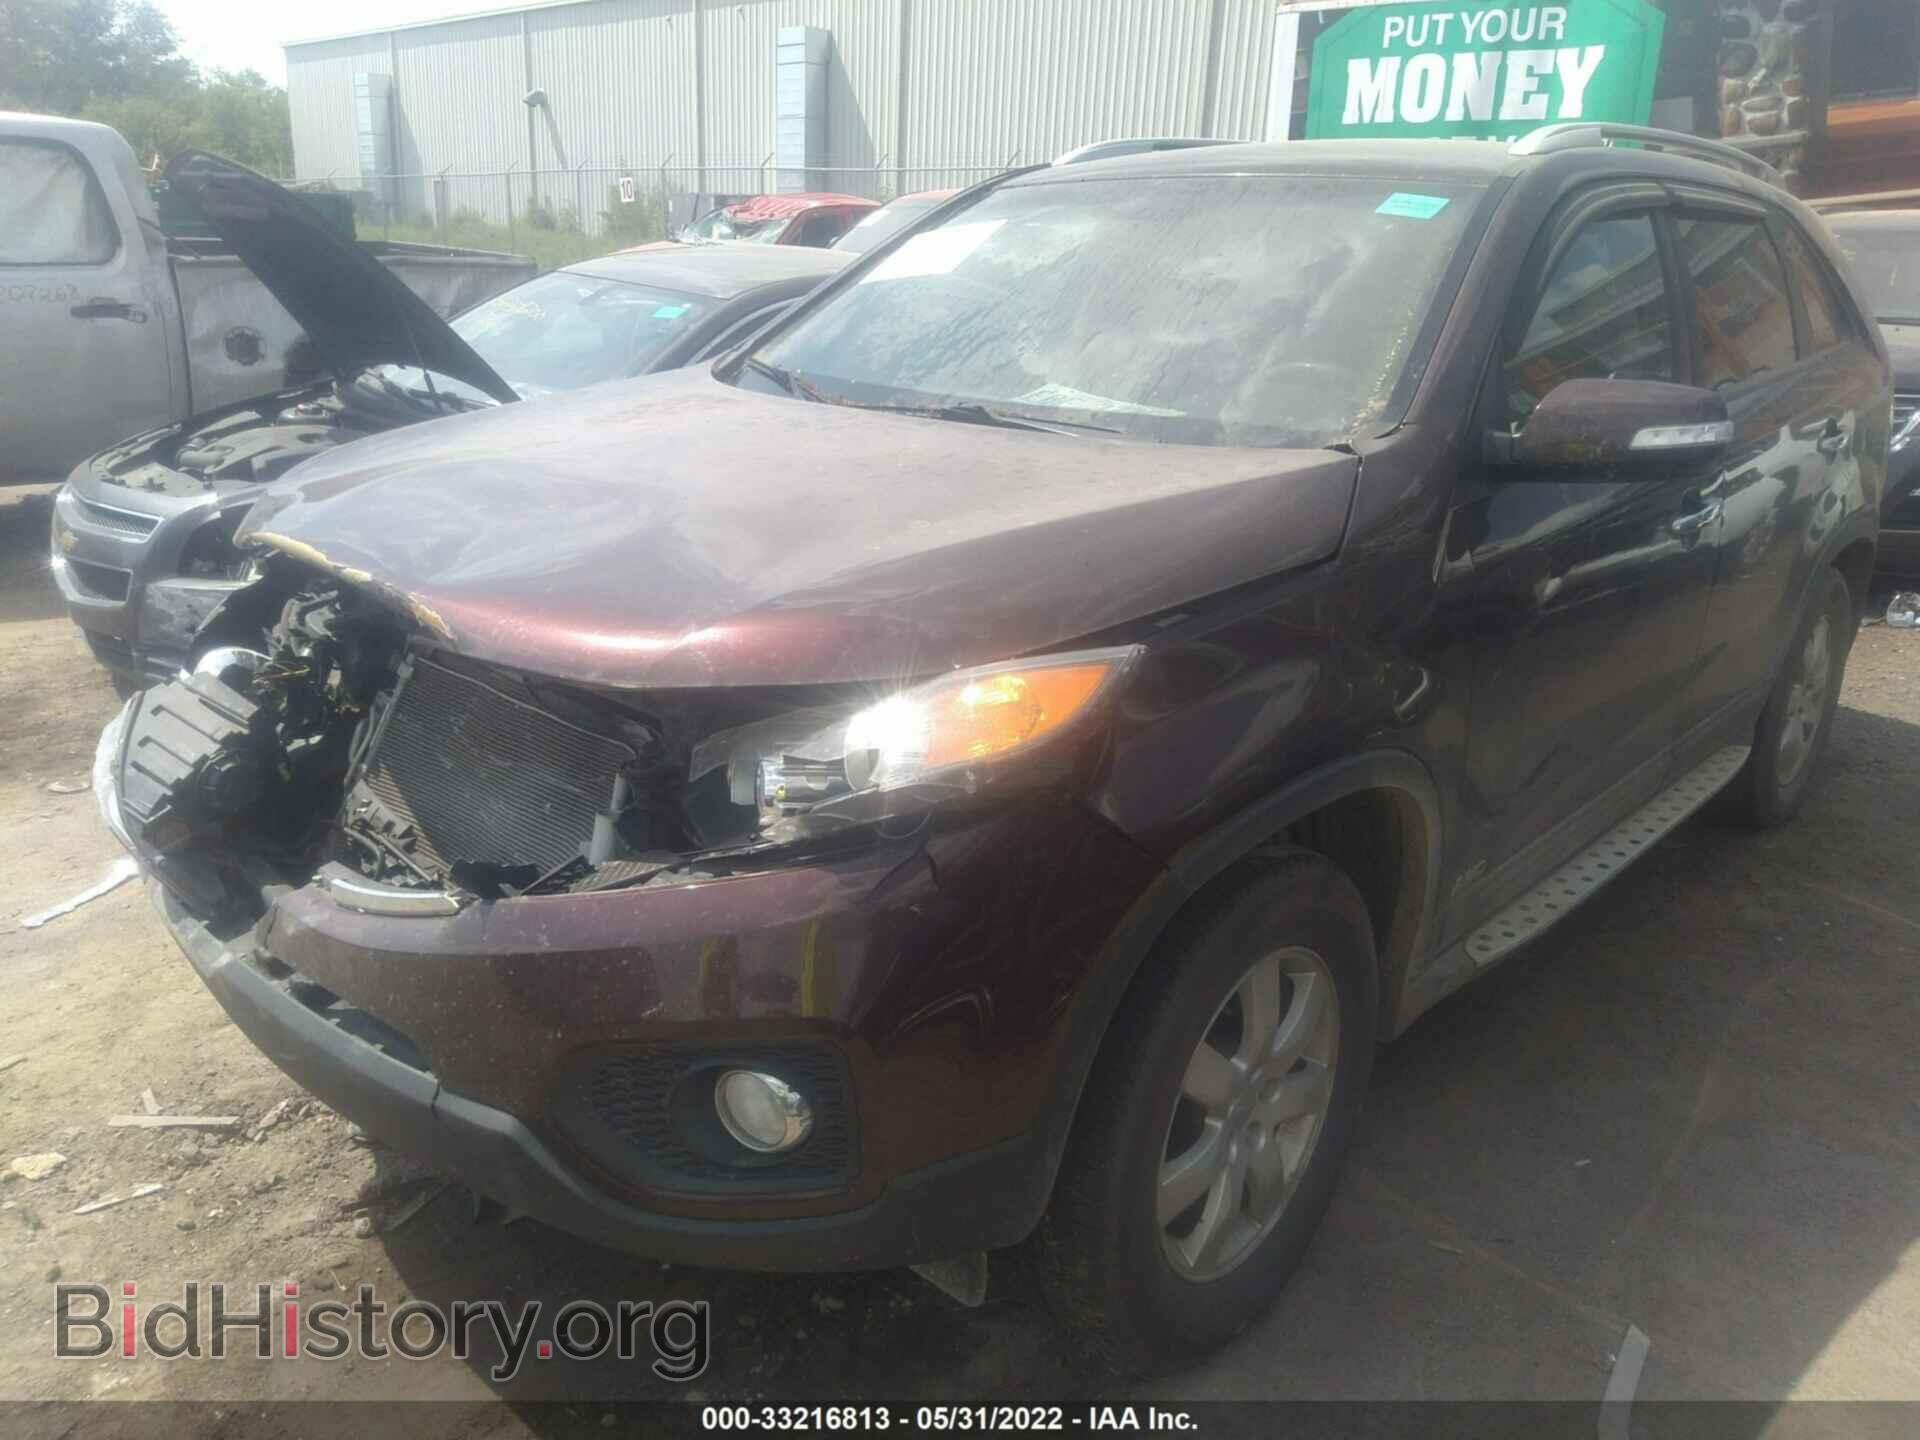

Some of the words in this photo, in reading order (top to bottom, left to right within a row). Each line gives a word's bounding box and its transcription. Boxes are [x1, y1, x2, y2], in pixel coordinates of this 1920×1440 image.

[1382, 12, 1454, 48] PUT
[1460, 7, 1568, 43] YOUR
[1341, 44, 1606, 125] MONEY
